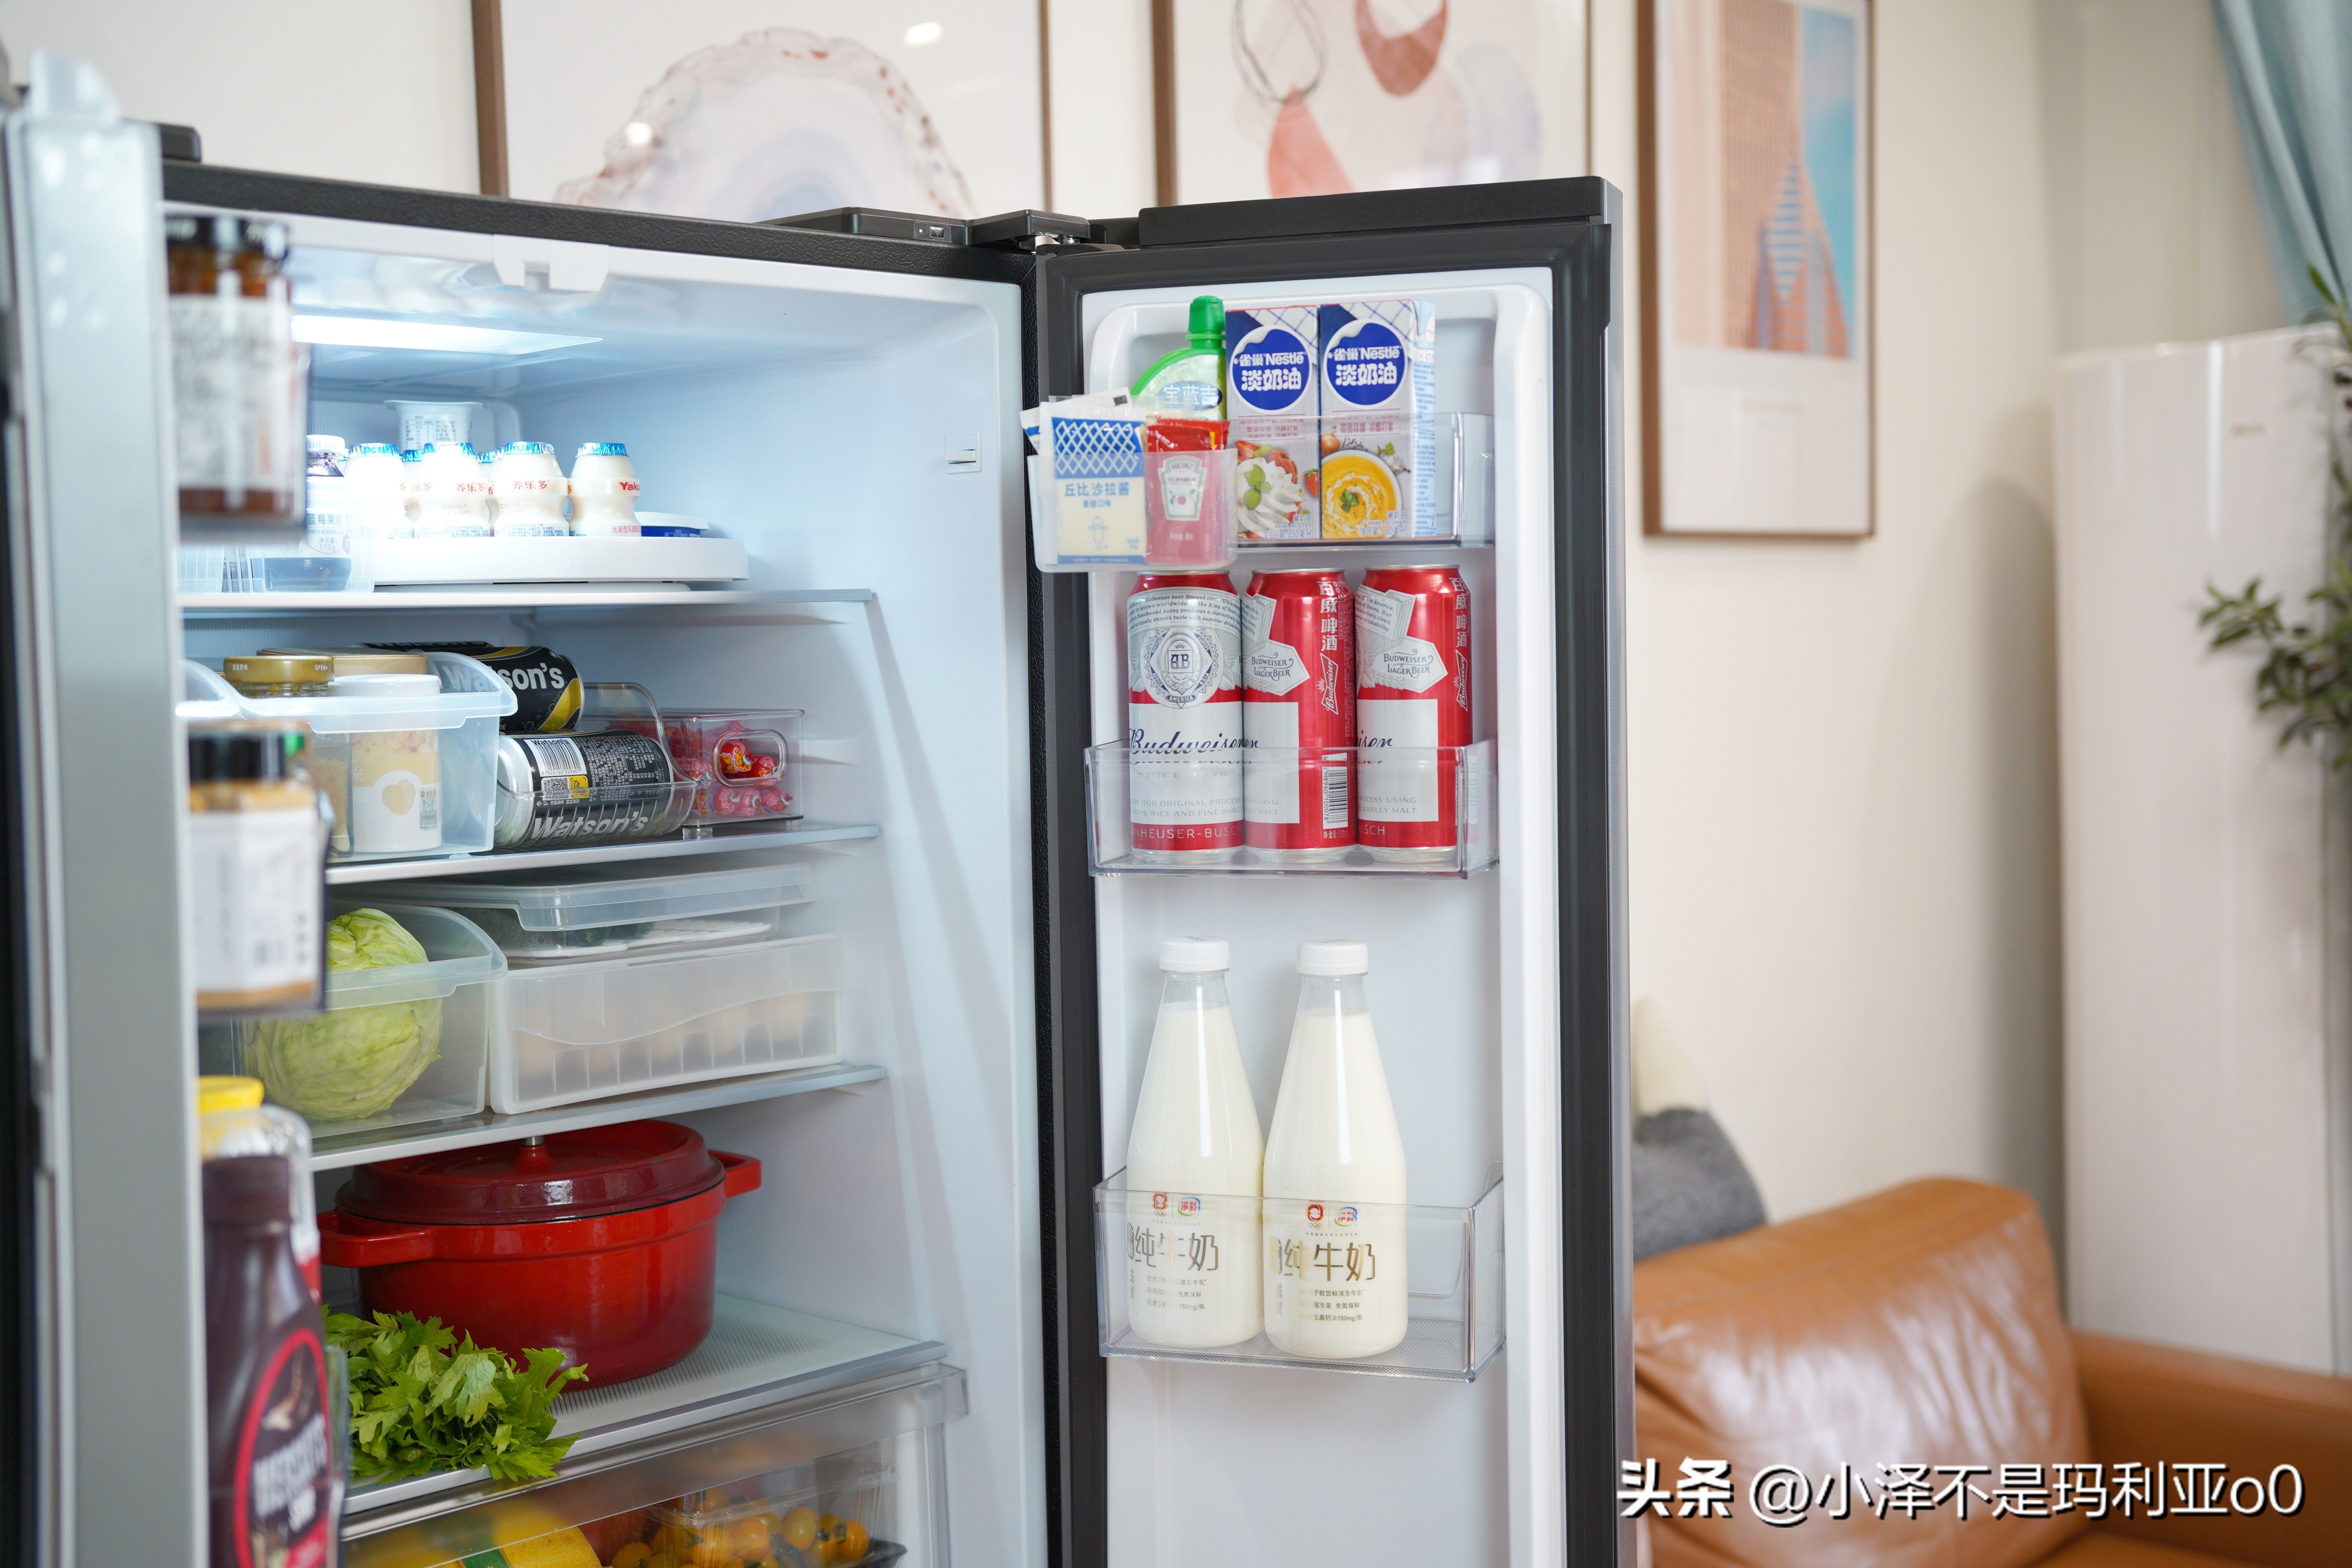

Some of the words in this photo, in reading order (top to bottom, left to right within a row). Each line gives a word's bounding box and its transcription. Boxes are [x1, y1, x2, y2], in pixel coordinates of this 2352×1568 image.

[1240, 354, 1265, 367] 雀巢
[1334, 347, 1359, 361] 雀巢
[1241, 367, 1302, 391] 淡奶油
[1336, 361, 1397, 386] 淡奶油
[1163, 385, 1220, 406] 宝蓝吉
[512, 480, 548, 490] 养乐多
[619, 482, 640, 491] Yaku
[1065, 482, 1129, 496] 丘比沙拉酱
[1367, 604, 1380, 613] Beers.
[1374, 600, 1394, 612] America,
[1449, 577, 1467, 648] 百威啤酒
[1316, 581, 1338, 651] 百威啤酒
[1377, 616, 1391, 625] clean,
[1171, 653, 1191, 669] AB
[1252, 656, 1288, 666] BUDWEISER
[1384, 653, 1427, 662] BUDWEISER
[1254, 666, 1273, 677] LAGER
[1273, 669, 1291, 677] BEER
[1388, 664, 1411, 675] LAGER
[1412, 666, 1430, 675] BEER
[1152, 672, 1163, 687] AFRICA
[1200, 672, 1210, 686] ASIA
[1325, 660, 1334, 711] Budweiser
[1209, 797, 1241, 805] PROCESS
[530, 811, 648, 839] Watson's
[1135, 1225, 1219, 1271] 纯牛奶
[1284, 1239, 1376, 1281] 纯牛奶
